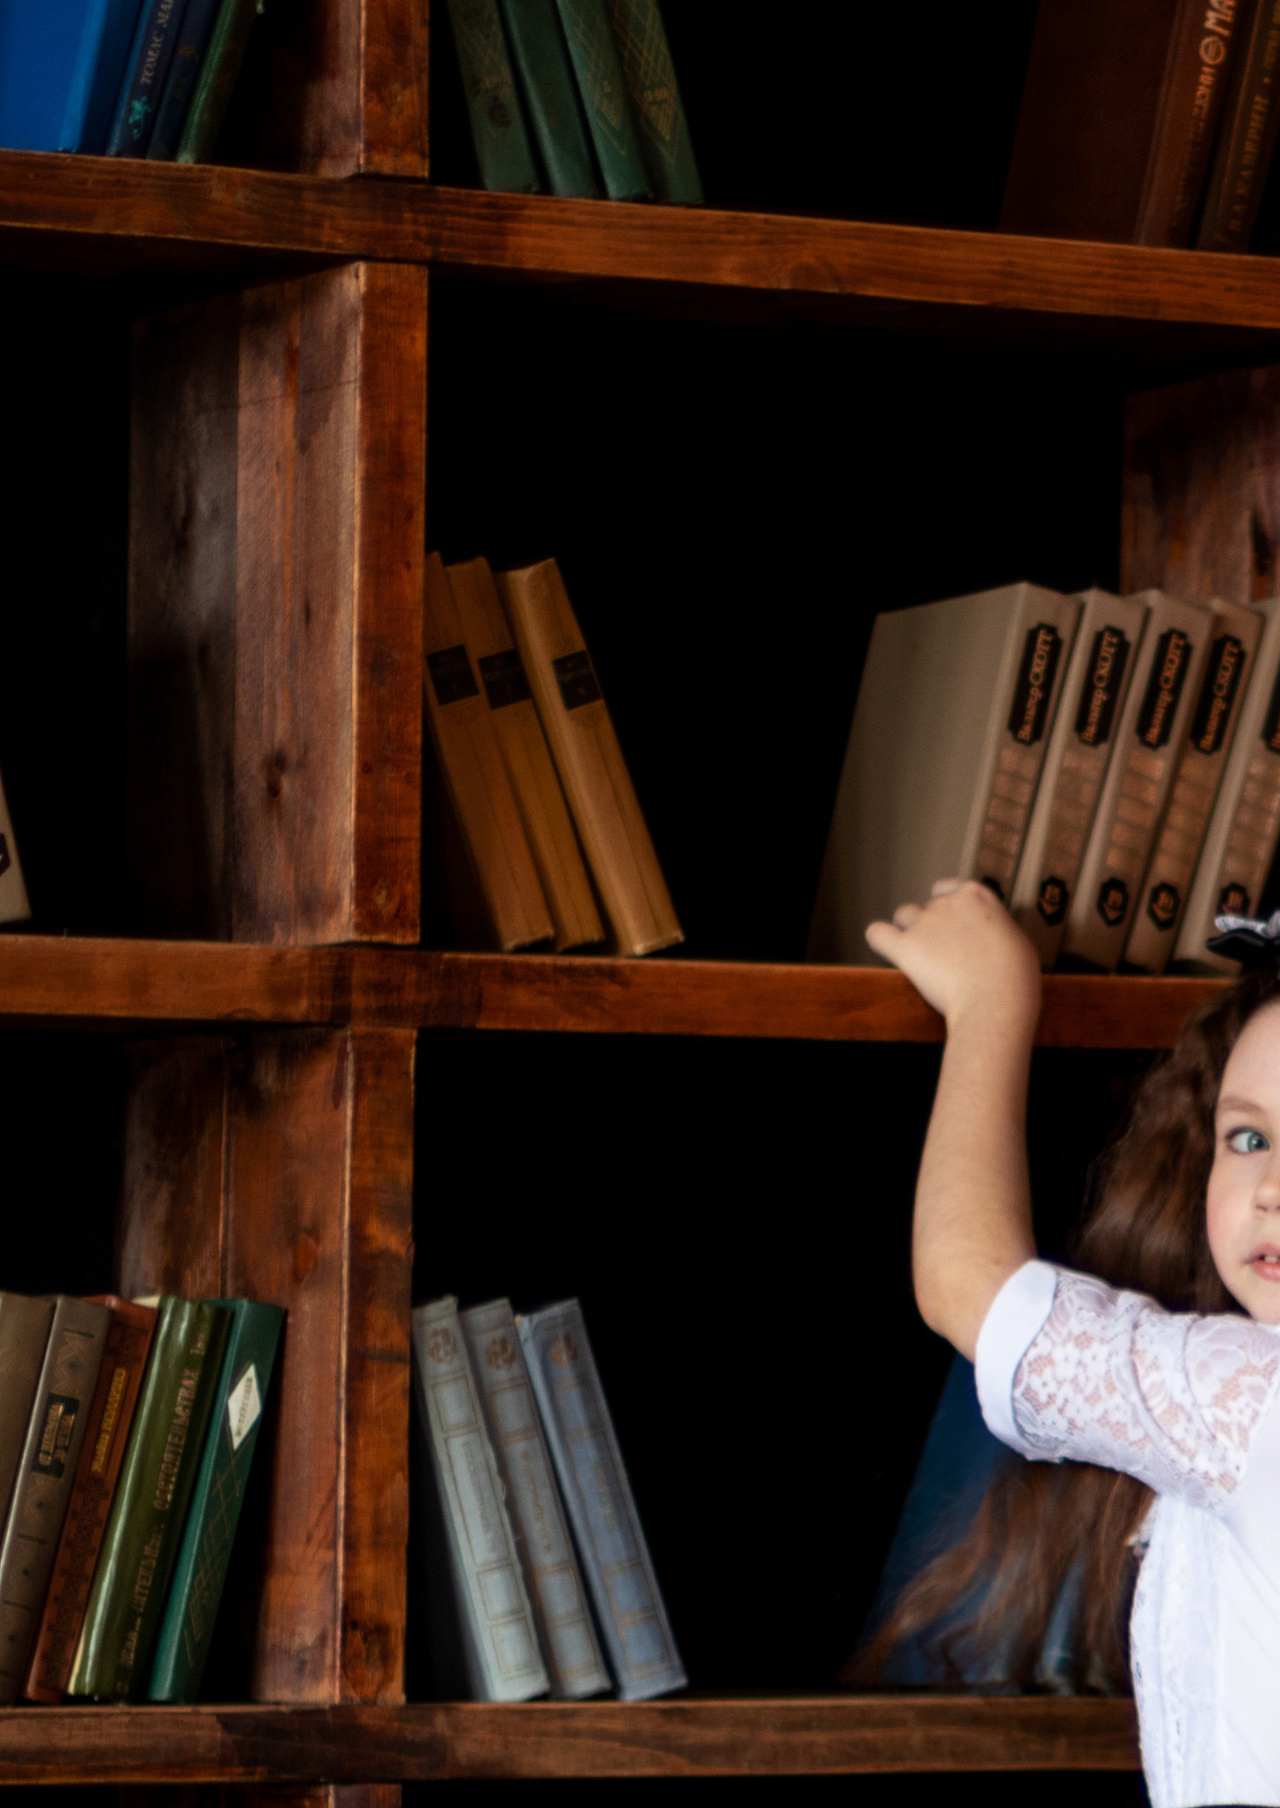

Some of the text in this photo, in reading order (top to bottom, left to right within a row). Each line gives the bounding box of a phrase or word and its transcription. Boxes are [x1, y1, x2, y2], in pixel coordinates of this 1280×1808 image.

[1019, 628, 1051, 740] Вальтер СКОТТ
[1081, 631, 1115, 741] Вальтер СКОТТ
[1144, 632, 1181, 743] Вальтер СКОТТ
[1200, 640, 1236, 750] Вальтер СКОТТ
